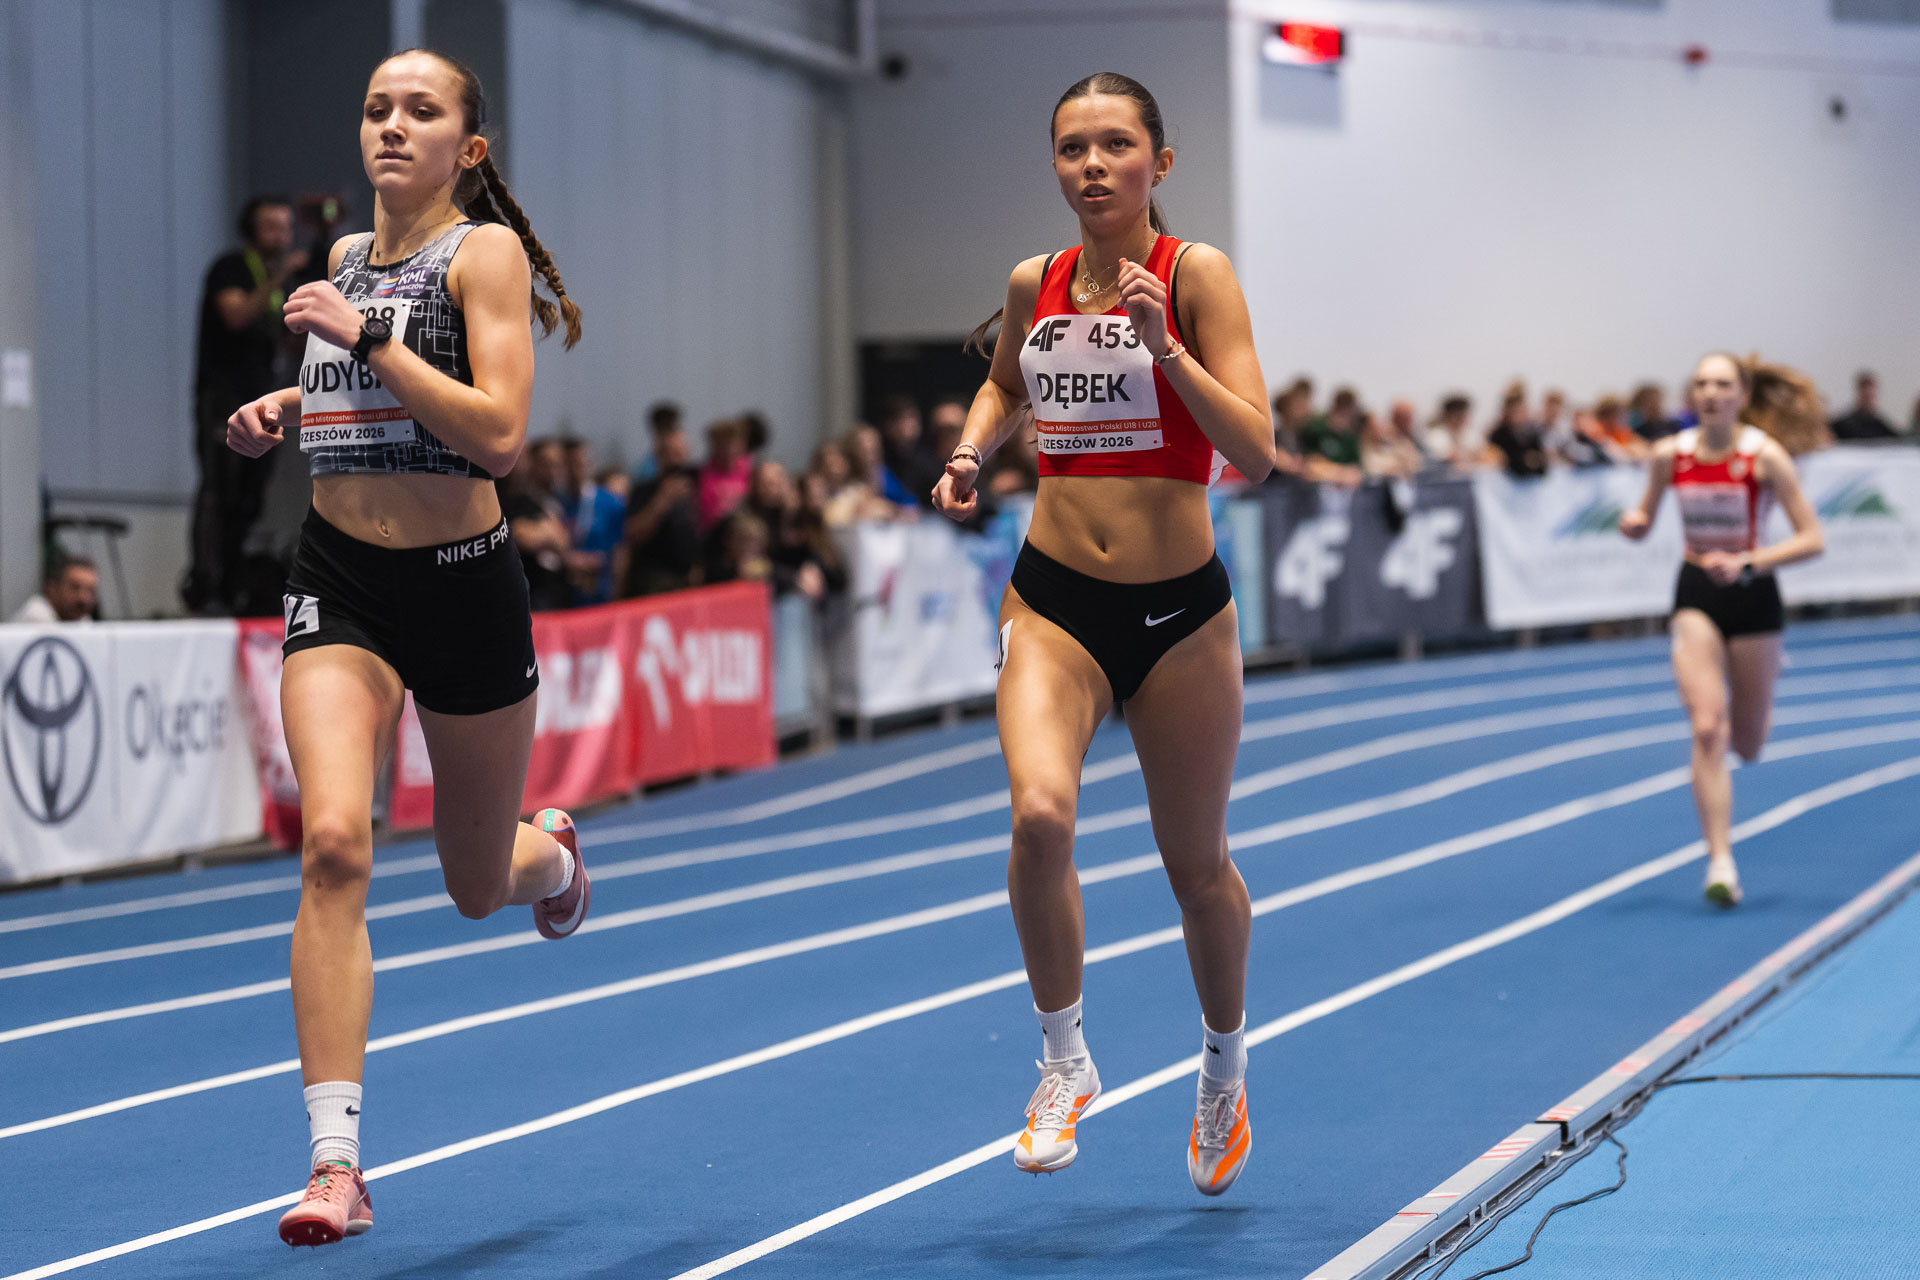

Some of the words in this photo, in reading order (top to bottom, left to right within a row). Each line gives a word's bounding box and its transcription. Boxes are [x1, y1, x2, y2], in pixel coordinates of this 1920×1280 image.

[397, 269, 427, 286] KML
[1028, 319, 1072, 352] 4F
[1087, 322, 1141, 350] 453
[301, 359, 382, 396] UDYB
[1035, 372, 1132, 410] DĘBEK
[315, 413, 356, 424] Mistrzostwa
[1055, 423, 1099, 432] Mistrzostwa
[1100, 421, 1122, 431] Polski
[1124, 421, 1137, 429] U18
[1142, 420, 1158, 429] U20
[355, 427, 386, 440] 2026
[1100, 436, 1134, 448] 2026
[437, 538, 487, 566] NIKE
